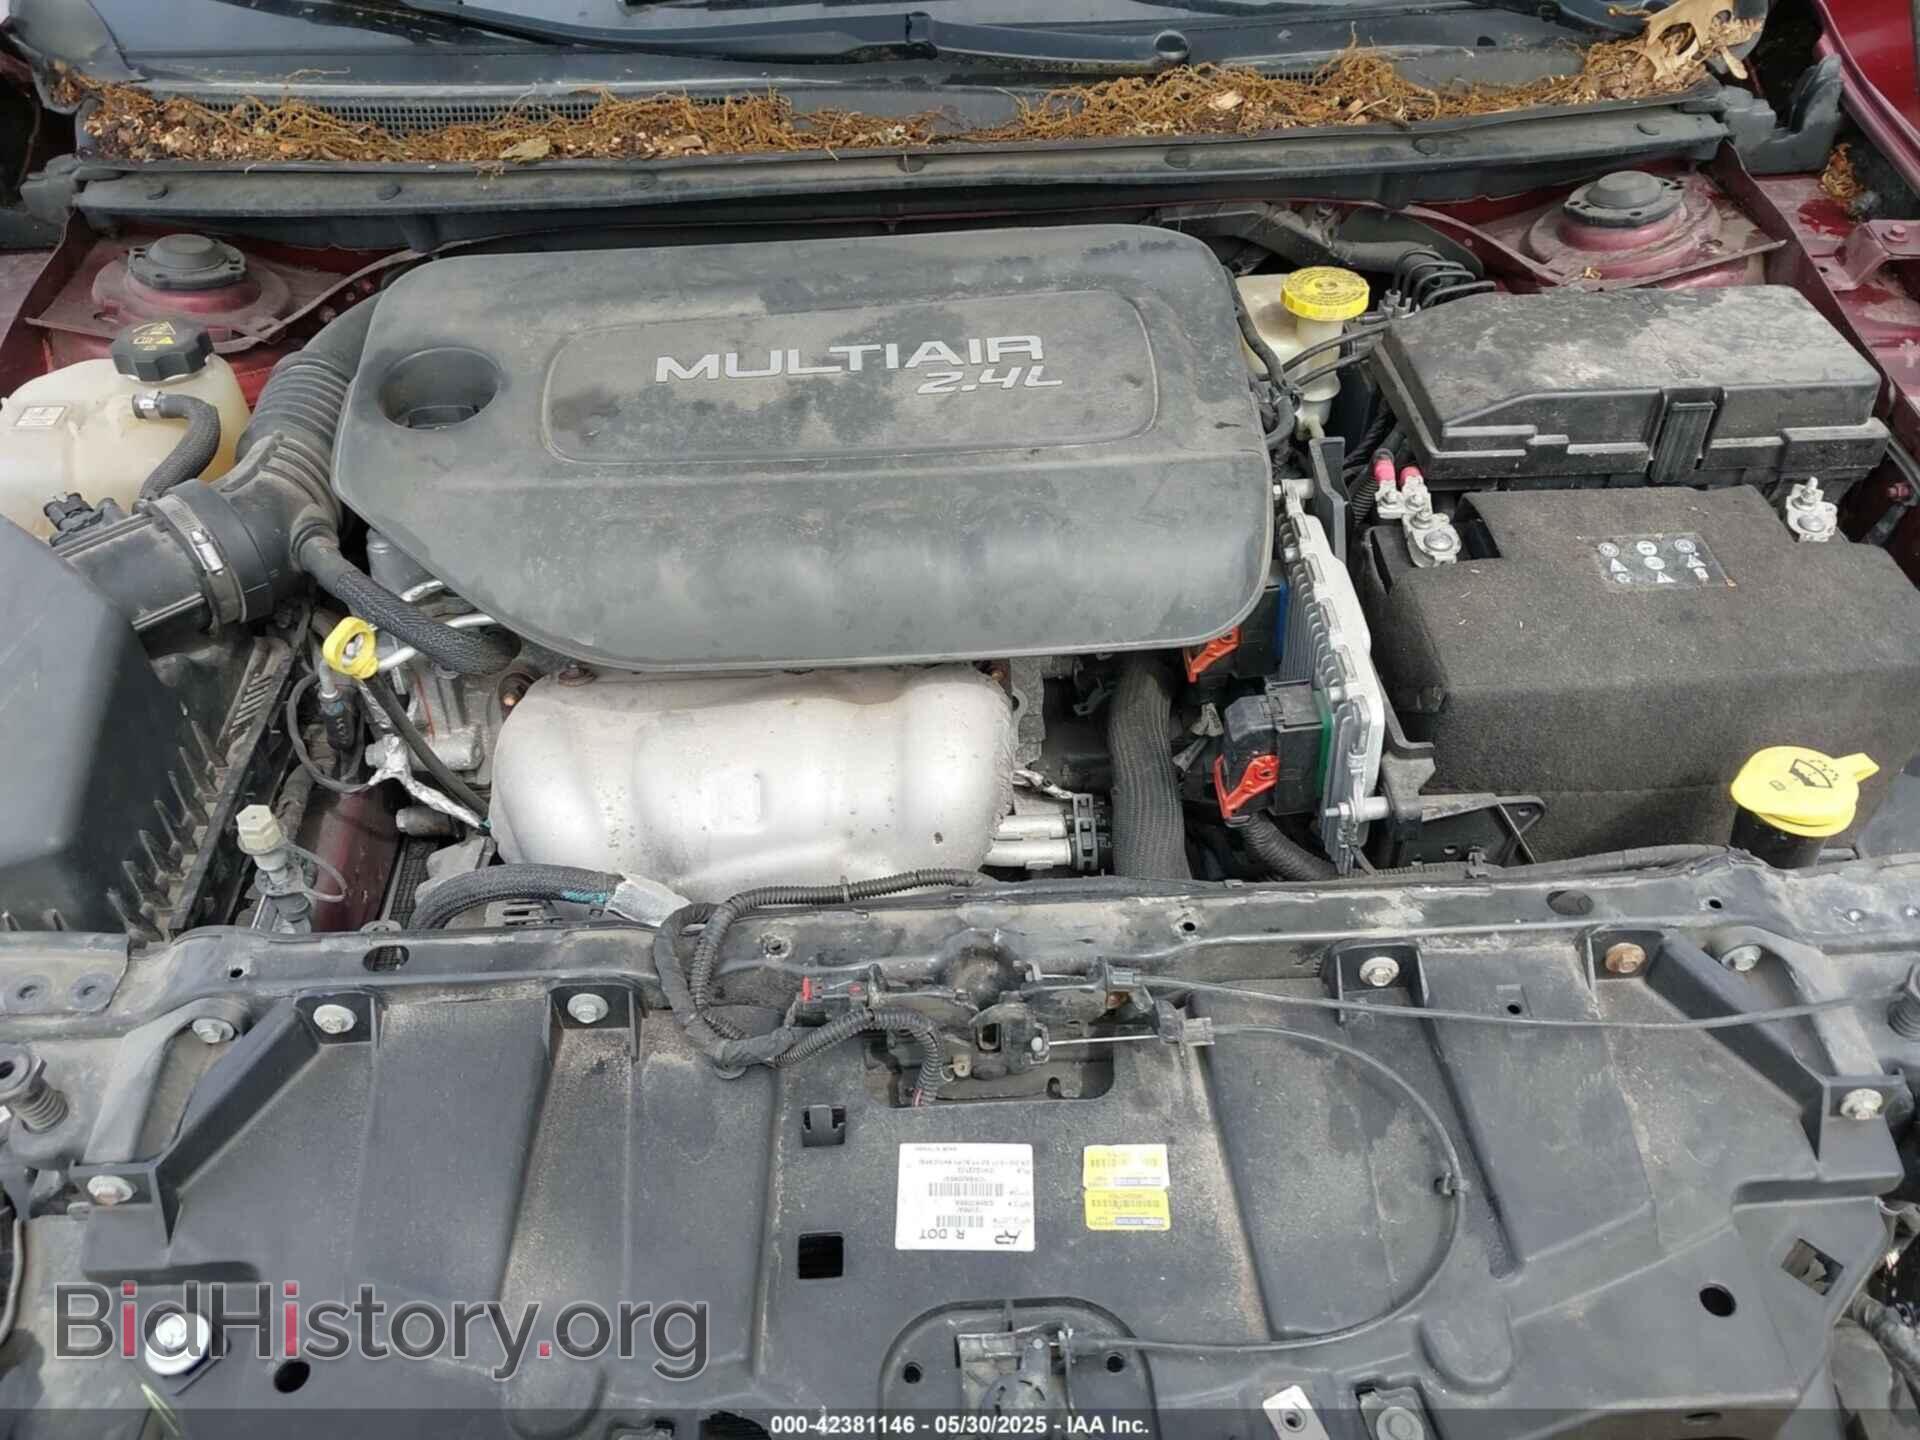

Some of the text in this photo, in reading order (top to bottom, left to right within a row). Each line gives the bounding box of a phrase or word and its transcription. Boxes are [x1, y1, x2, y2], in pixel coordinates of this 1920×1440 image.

[655, 334, 1044, 384] MULTIAIR
[917, 365, 1064, 395] 2.4L
[918, 1228, 948, 1240] DOT
